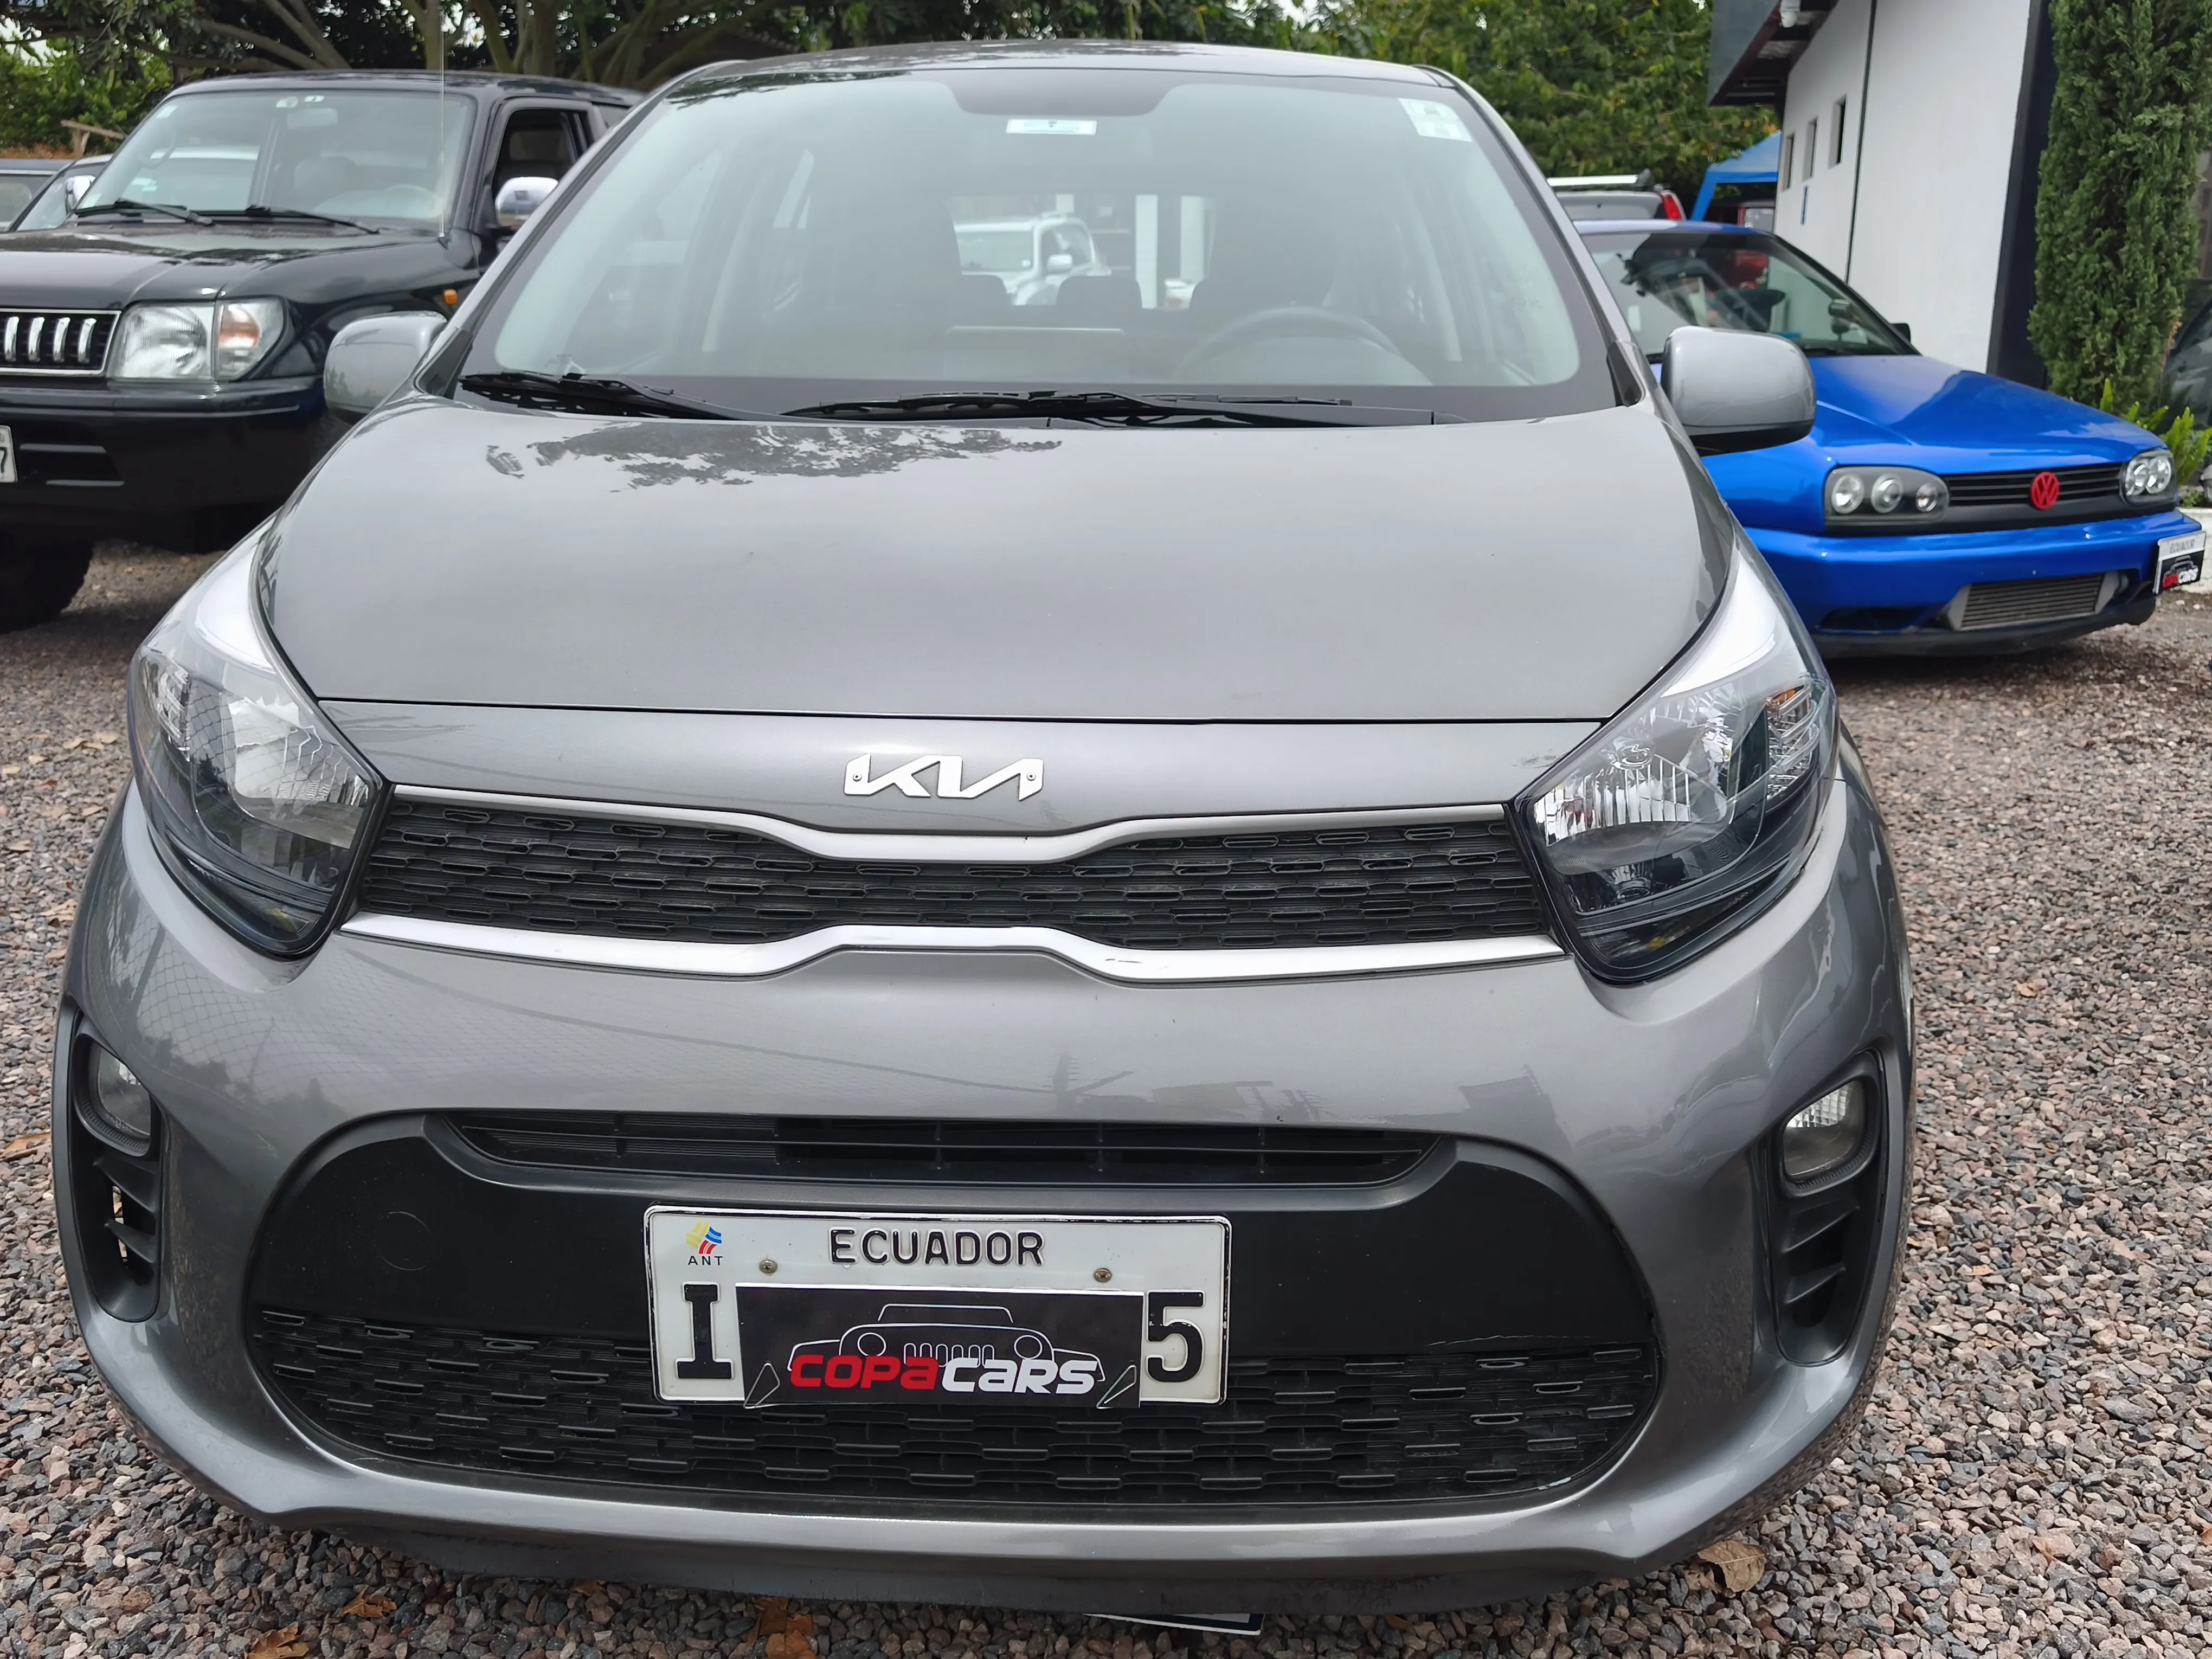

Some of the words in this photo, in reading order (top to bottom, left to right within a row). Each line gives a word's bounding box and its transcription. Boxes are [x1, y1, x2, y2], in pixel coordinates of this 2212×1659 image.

[844, 753, 1044, 801] KIA
[687, 1255, 723, 1266] ANT
[830, 1229, 1043, 1266] ECUADOR
[1146, 1291, 1204, 1382] 5
